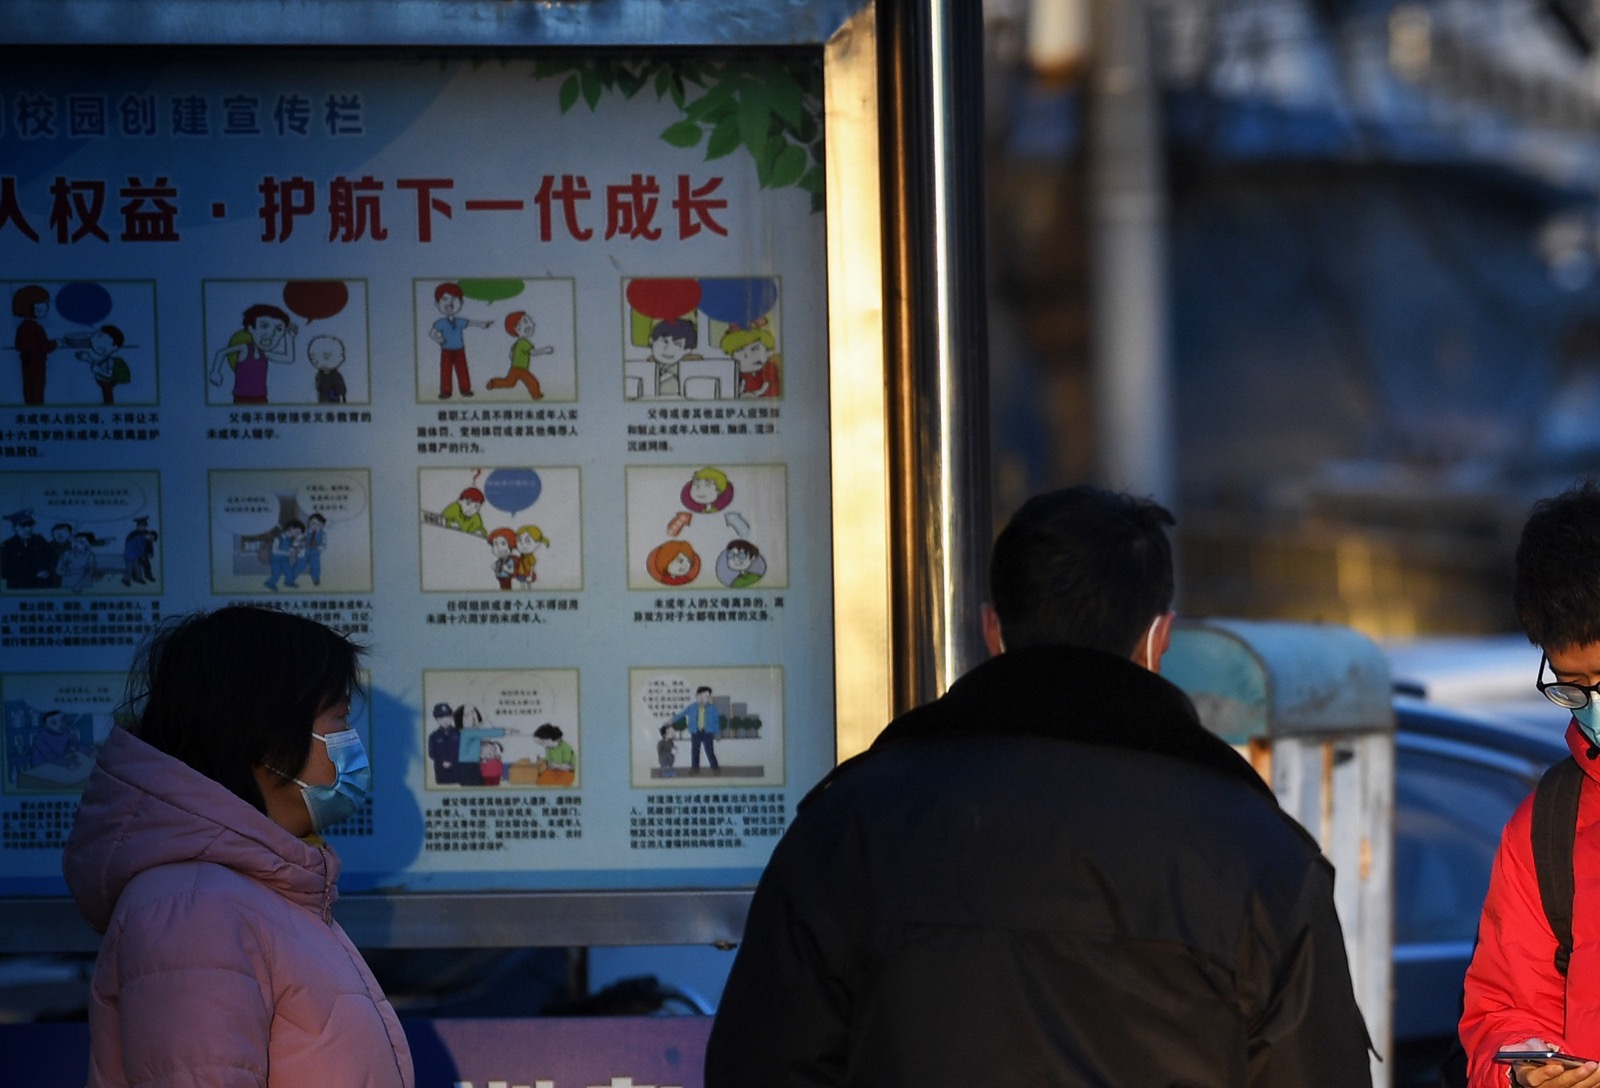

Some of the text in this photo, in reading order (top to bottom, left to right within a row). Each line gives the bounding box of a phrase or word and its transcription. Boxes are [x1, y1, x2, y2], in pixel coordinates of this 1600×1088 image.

[0, 94, 363, 136] 校园创建宣传栏
[0, 175, 729, 243] 人权益·护航下一代成长
